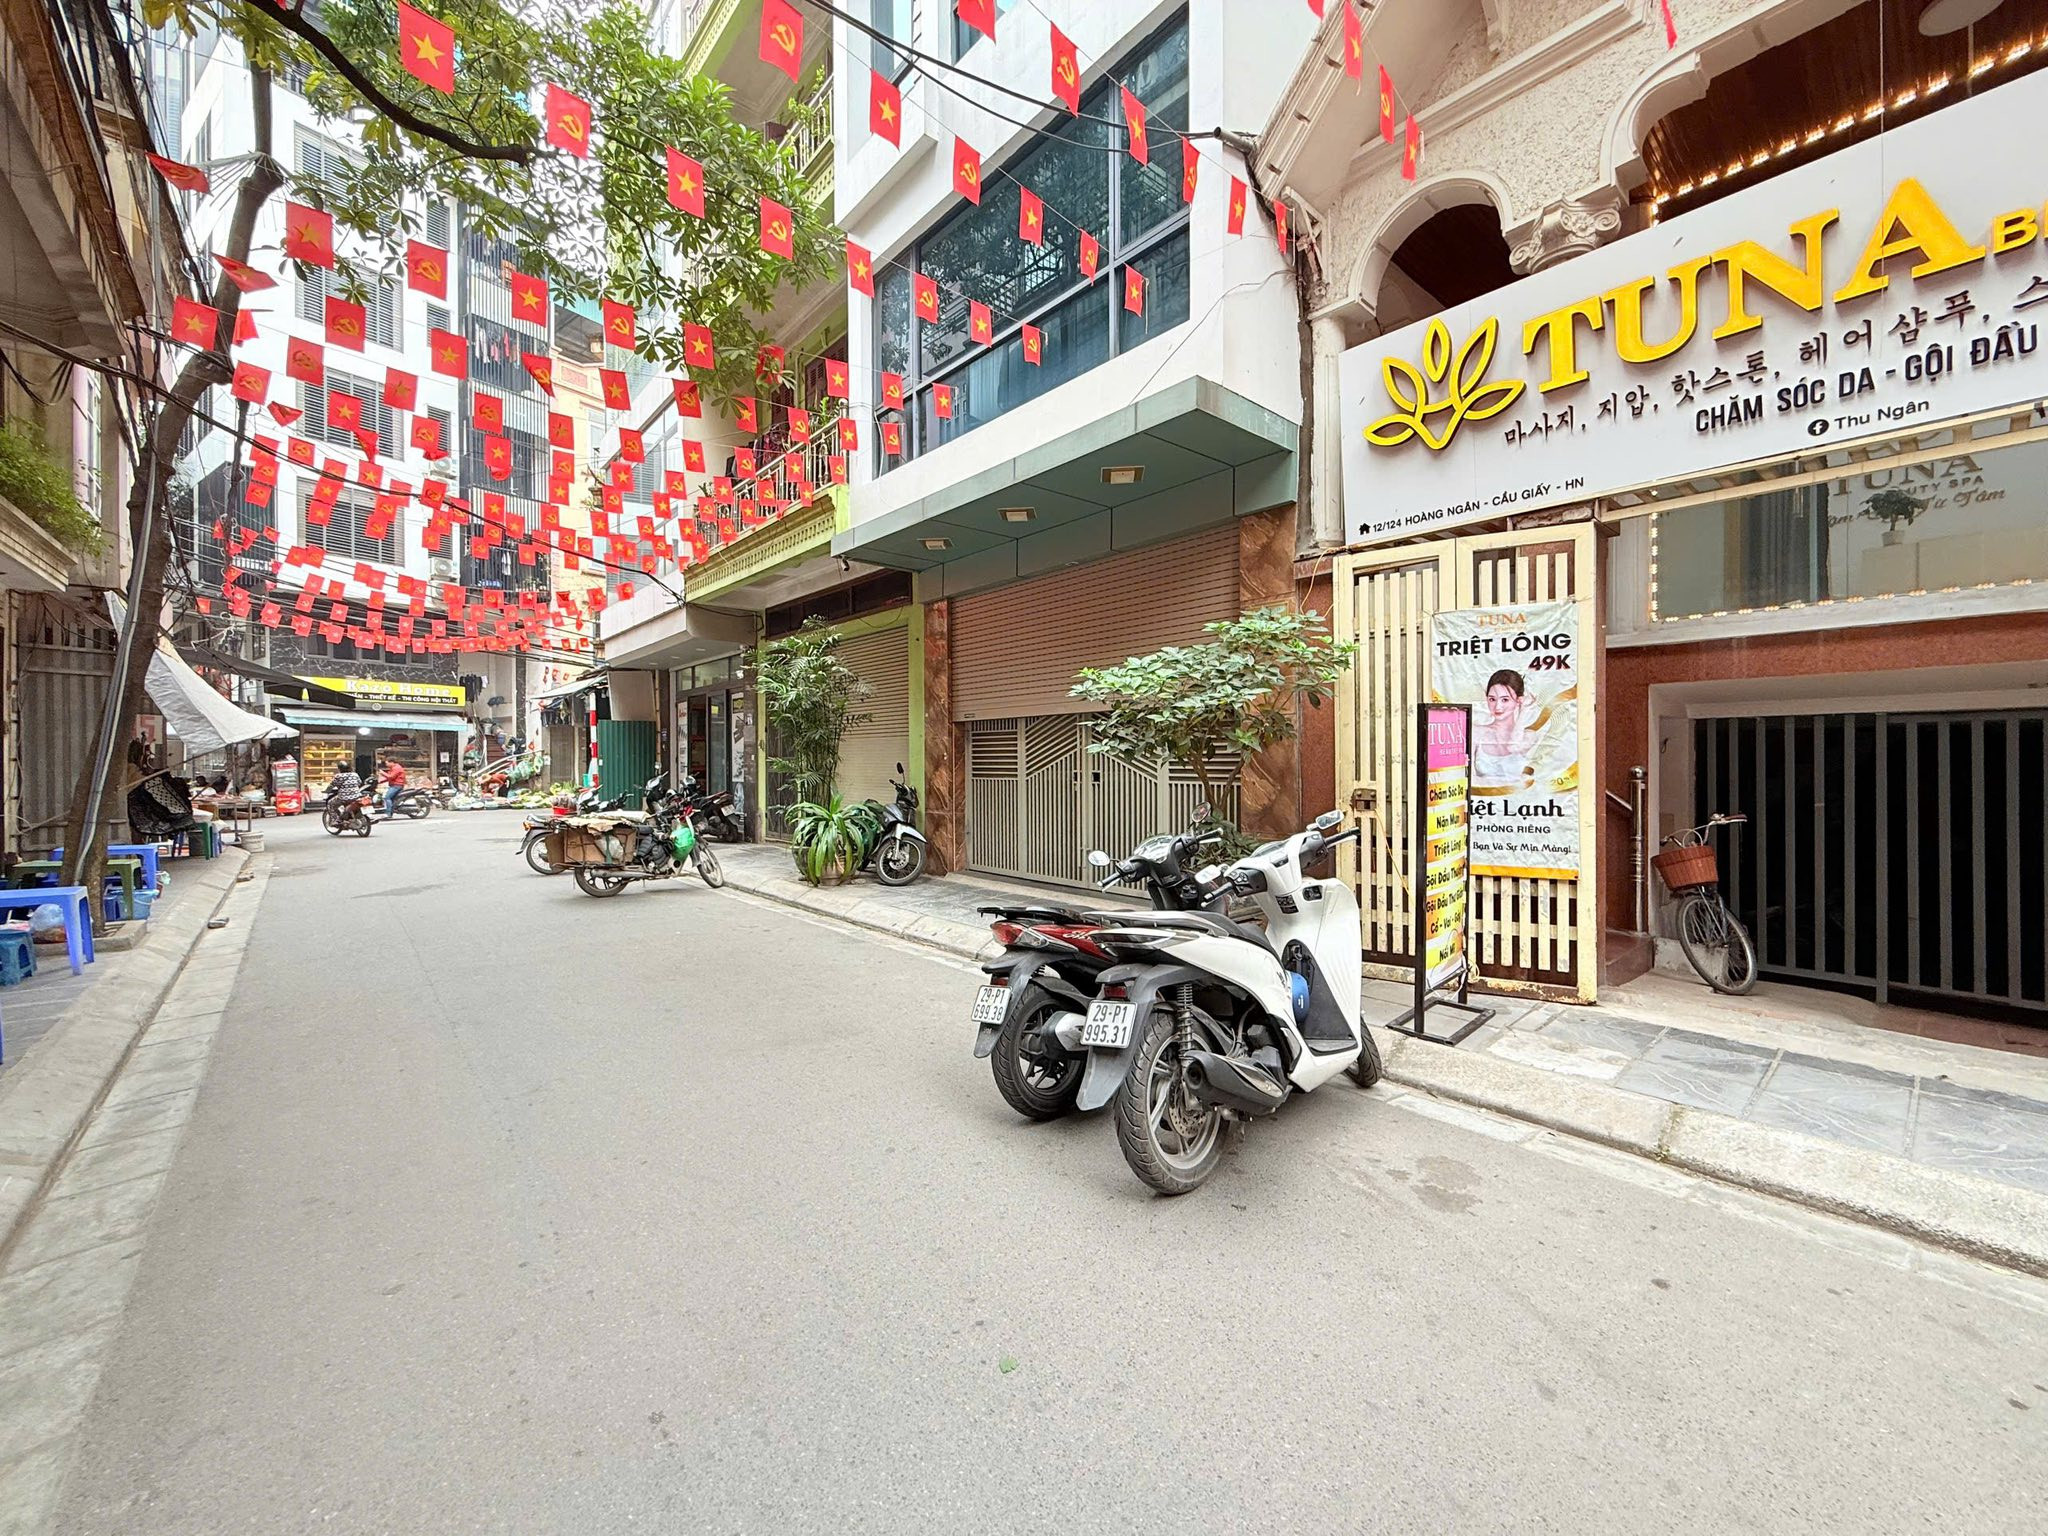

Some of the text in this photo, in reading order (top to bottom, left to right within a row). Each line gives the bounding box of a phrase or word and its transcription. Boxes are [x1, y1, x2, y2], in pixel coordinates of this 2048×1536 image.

[1522, 176, 2048, 394] TUNA B
[1696, 394, 1763, 433] CHĂM
[1777, 376, 1826, 413] SÓC
[1839, 366, 1875, 398] DA
[1905, 341, 1953, 383] GỘI
[1969, 320, 2038, 366] ĐẦU
[1504, 404, 1587, 448] 마사지,
[1598, 384, 1659, 421] 지압,
[1672, 349, 1780, 408] 핫스톤,
[1834, 400, 1930, 430] Thu Ngân
[1949, 475, 1984, 489] SPA
[1372, 518, 1402, 533] 12/124
[1405, 508, 1444, 526] HOÀNG
[1447, 500, 1480, 516] NGÂN
[1521, 482, 1551, 500] GIẤY
[1565, 477, 1584, 491] HN
[1477, 612, 1527, 627] TUNA
[1437, 632, 1571, 659] TRIỆT LÔNG
[1528, 654, 1571, 671] 49K
[399, 682, 451, 696] Home
[1428, 722, 1464, 746] TUNA
[1429, 786, 1448, 802] Chăm
[1470, 799, 1565, 820] iệt Lạnh
[1476, 823, 1551, 834] PHÒNG RIÊNG
[1434, 841, 1449, 857] Triệt
[1473, 842, 1490, 851] Bạn
[1492, 842, 1504, 851] Và
[1506, 843, 1518, 852] Sự
[1520, 843, 1539, 853] Mịn
[980, 987, 1006, 1003] 29-P1
[973, 1005, 1004, 1021] 699.38
[1092, 1004, 1128, 1024] 29-P1
[1084, 1024, 1128, 1045] 995.31
